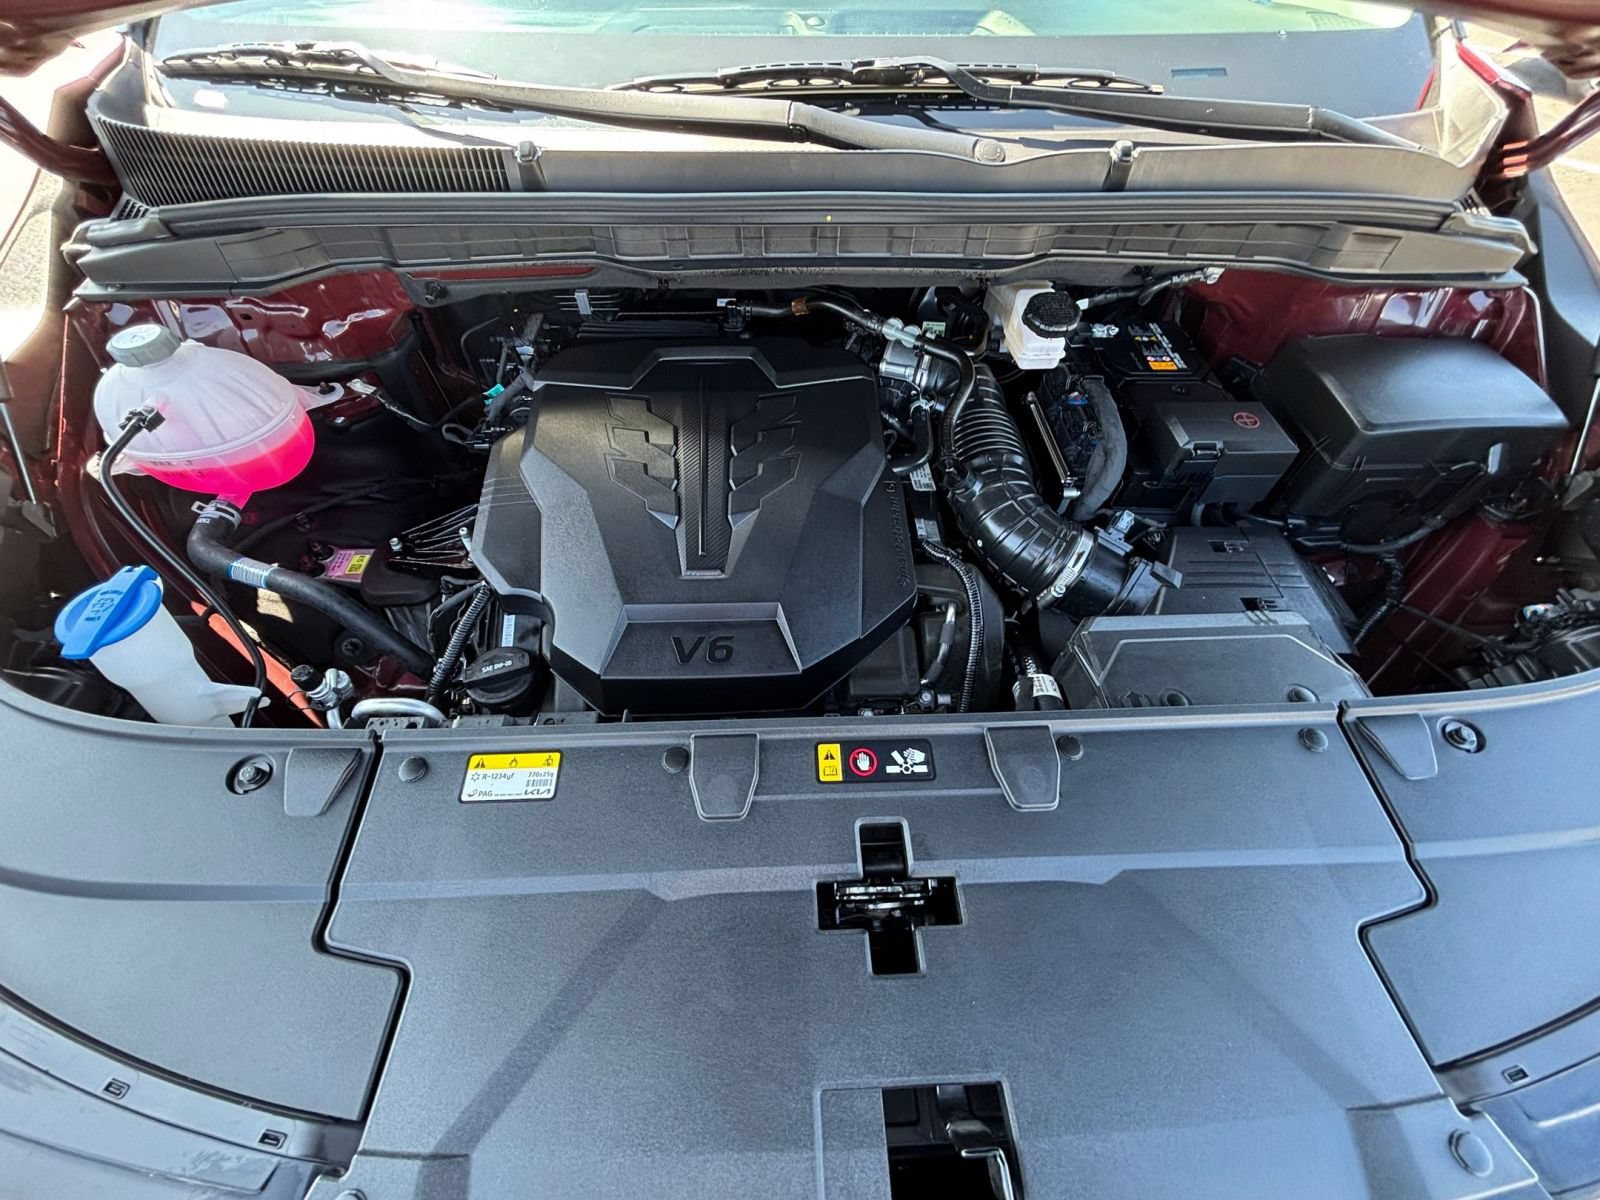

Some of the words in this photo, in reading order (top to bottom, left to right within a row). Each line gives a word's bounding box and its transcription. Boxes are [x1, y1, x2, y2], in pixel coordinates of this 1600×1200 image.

[671, 636, 735, 663] V6
[482, 665, 493, 673] SAE
[482, 772, 515, 781] R-1234yf
[524, 788, 551, 796] KIA
